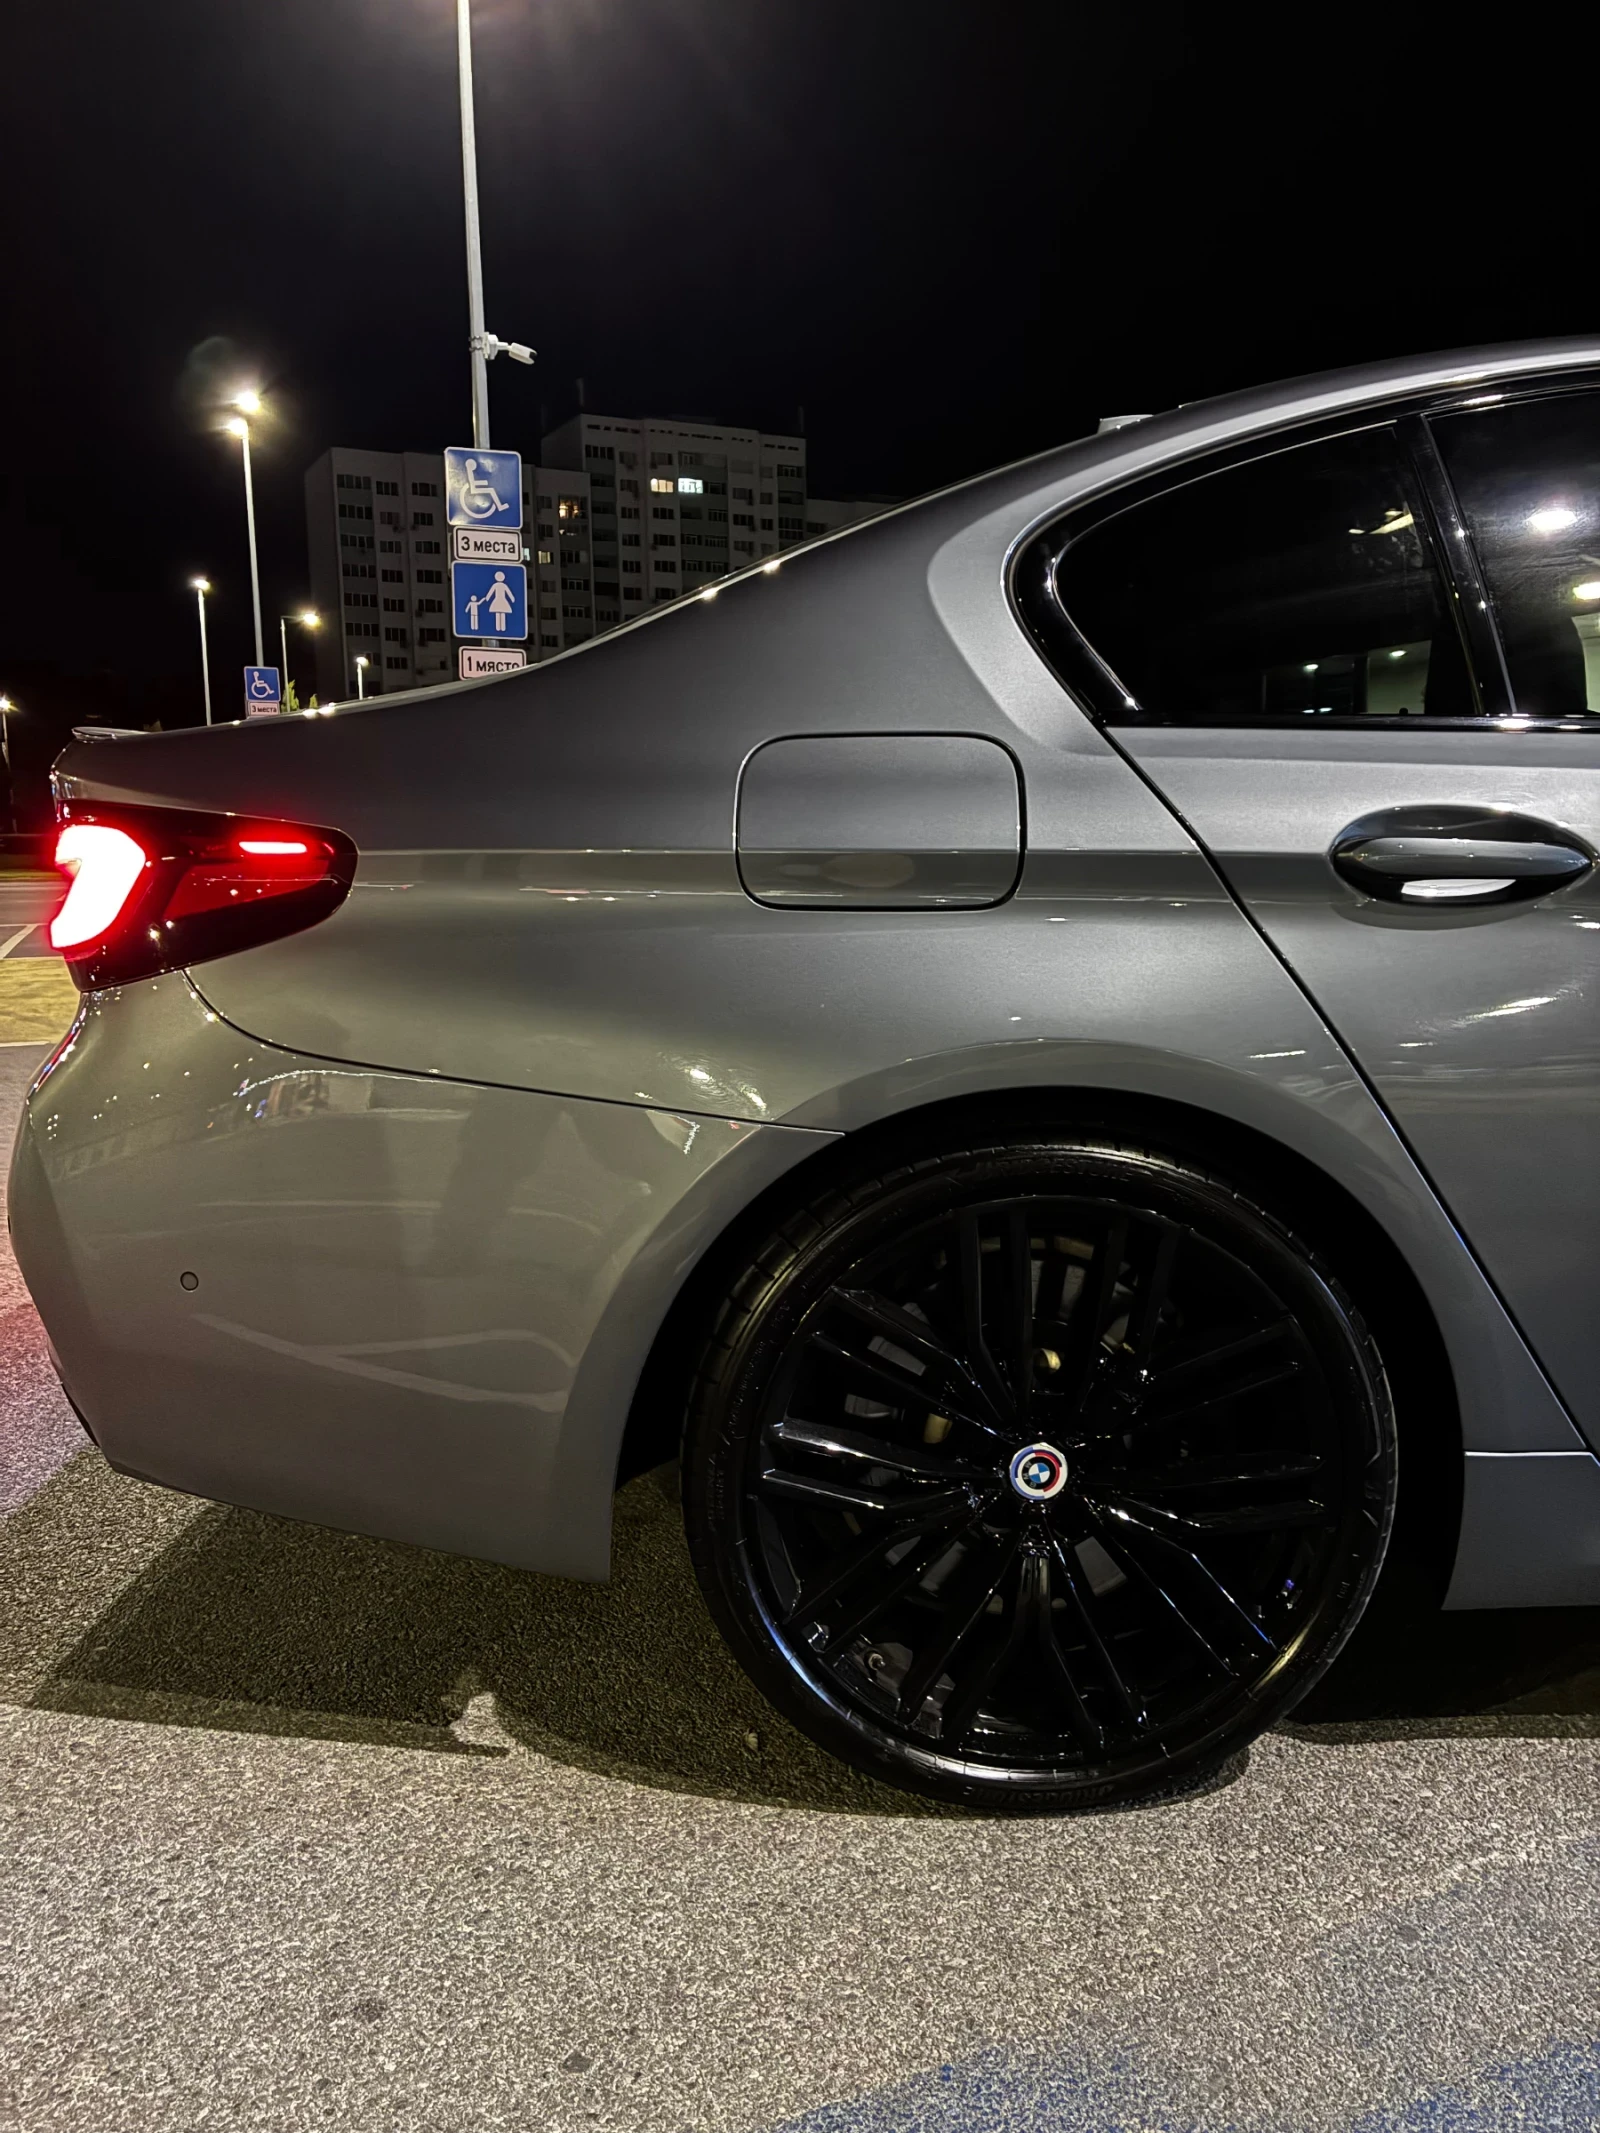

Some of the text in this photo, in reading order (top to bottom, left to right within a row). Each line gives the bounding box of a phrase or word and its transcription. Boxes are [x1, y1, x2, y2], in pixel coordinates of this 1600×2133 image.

[461, 536, 516, 554] 3 места
[467, 656, 472, 671] 1
[252, 705, 256, 713] 3
